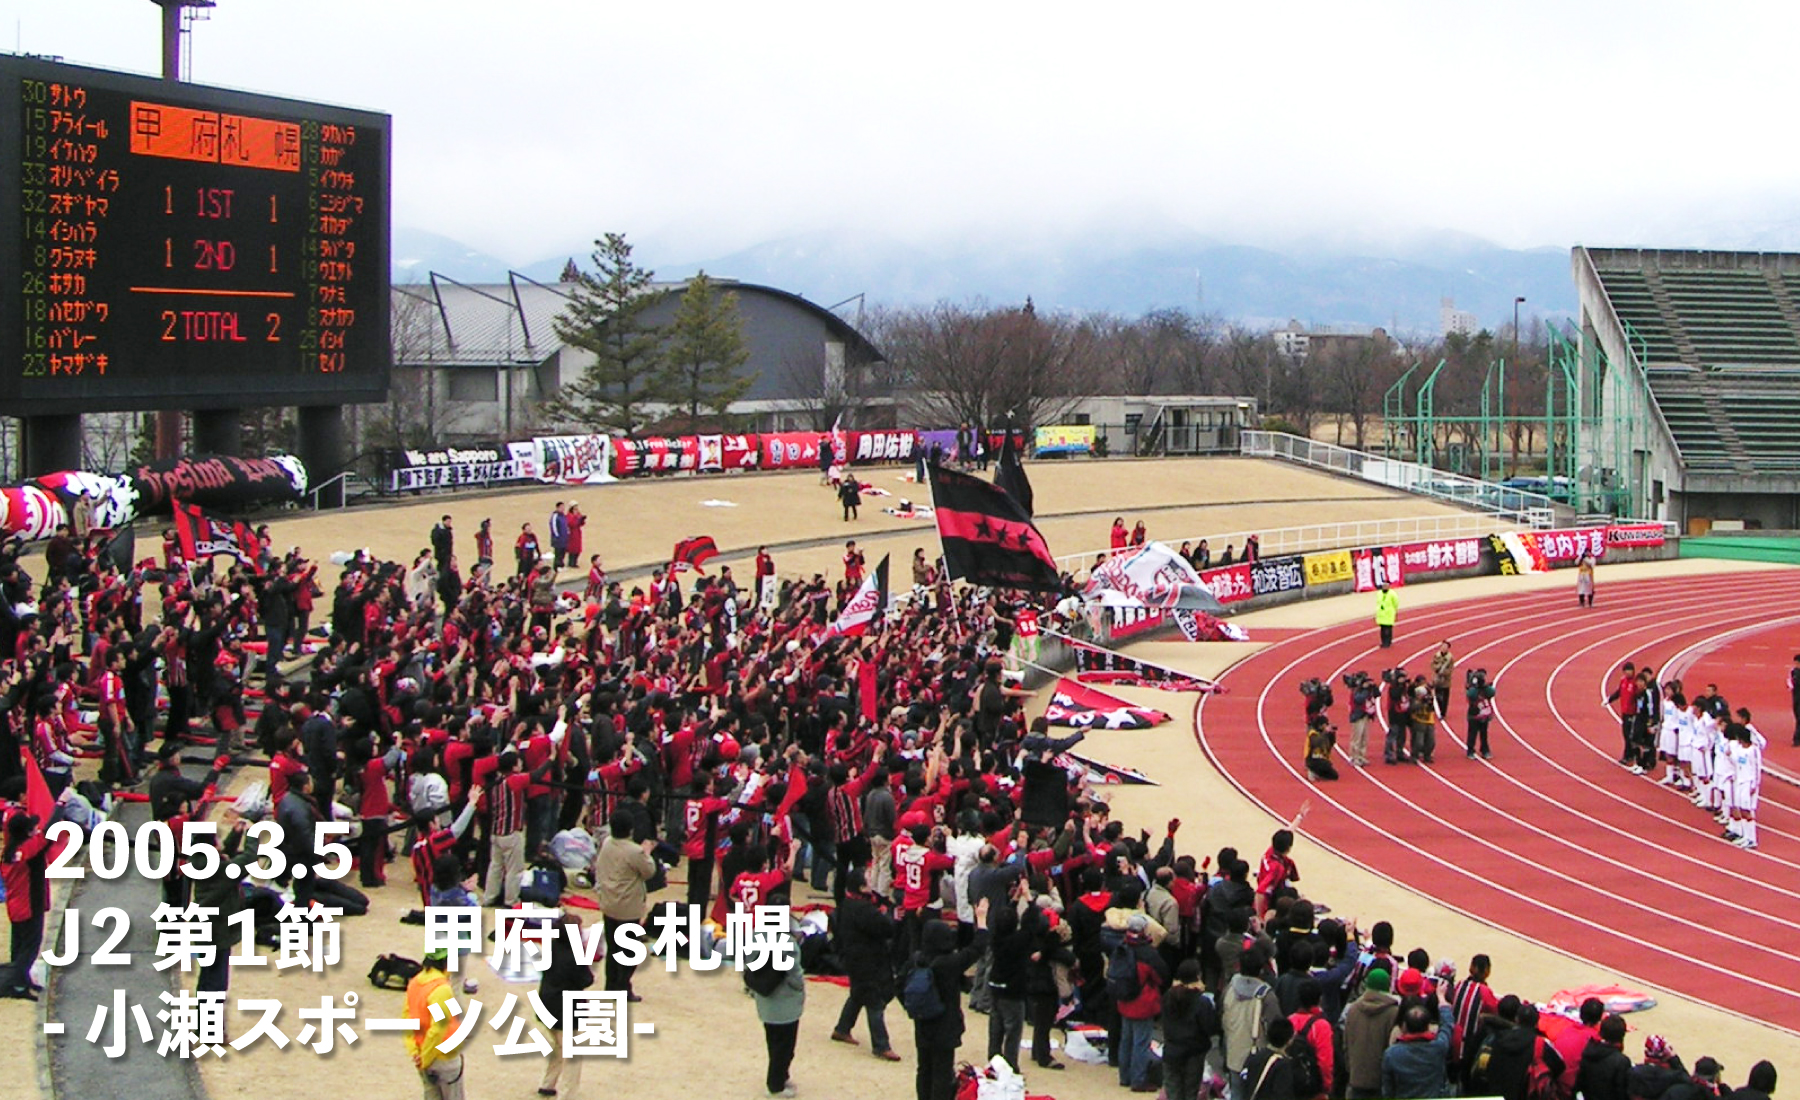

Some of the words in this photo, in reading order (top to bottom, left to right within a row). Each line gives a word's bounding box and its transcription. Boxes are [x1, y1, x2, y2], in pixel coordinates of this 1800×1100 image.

[22, 79, 46, 104] 30
[51, 83, 87, 108] サトウ
[25, 107, 46, 131] 15
[51, 110, 108, 139] アライール
[25, 134, 46, 158] 19
[50, 139, 98, 164] イケハタ
[22, 162, 46, 186] 33
[22, 190, 46, 213] 32
[165, 185, 173, 214] 1
[197, 189, 235, 219] 1ST
[270, 195, 277, 223] 1
[25, 217, 46, 239] 14
[49, 220, 97, 242] イシハラ
[31, 245, 46, 267] 8
[49, 246, 97, 269] クラヌキ
[165, 238, 172, 267] 1
[194, 240, 236, 271] 2ND
[270, 245, 277, 273] 1
[22, 271, 46, 294] 26
[49, 273, 86, 295] ホサカ
[25, 299, 46, 321] 18
[25, 326, 46, 348] 16
[161, 310, 177, 342] 2
[181, 311, 247, 342] TOTAL
[266, 312, 281, 342] 2
[22, 354, 46, 376] 23
[405, 449, 427, 466] We
[427, 451, 449, 465] are
[448, 447, 498, 464] Sapporo
